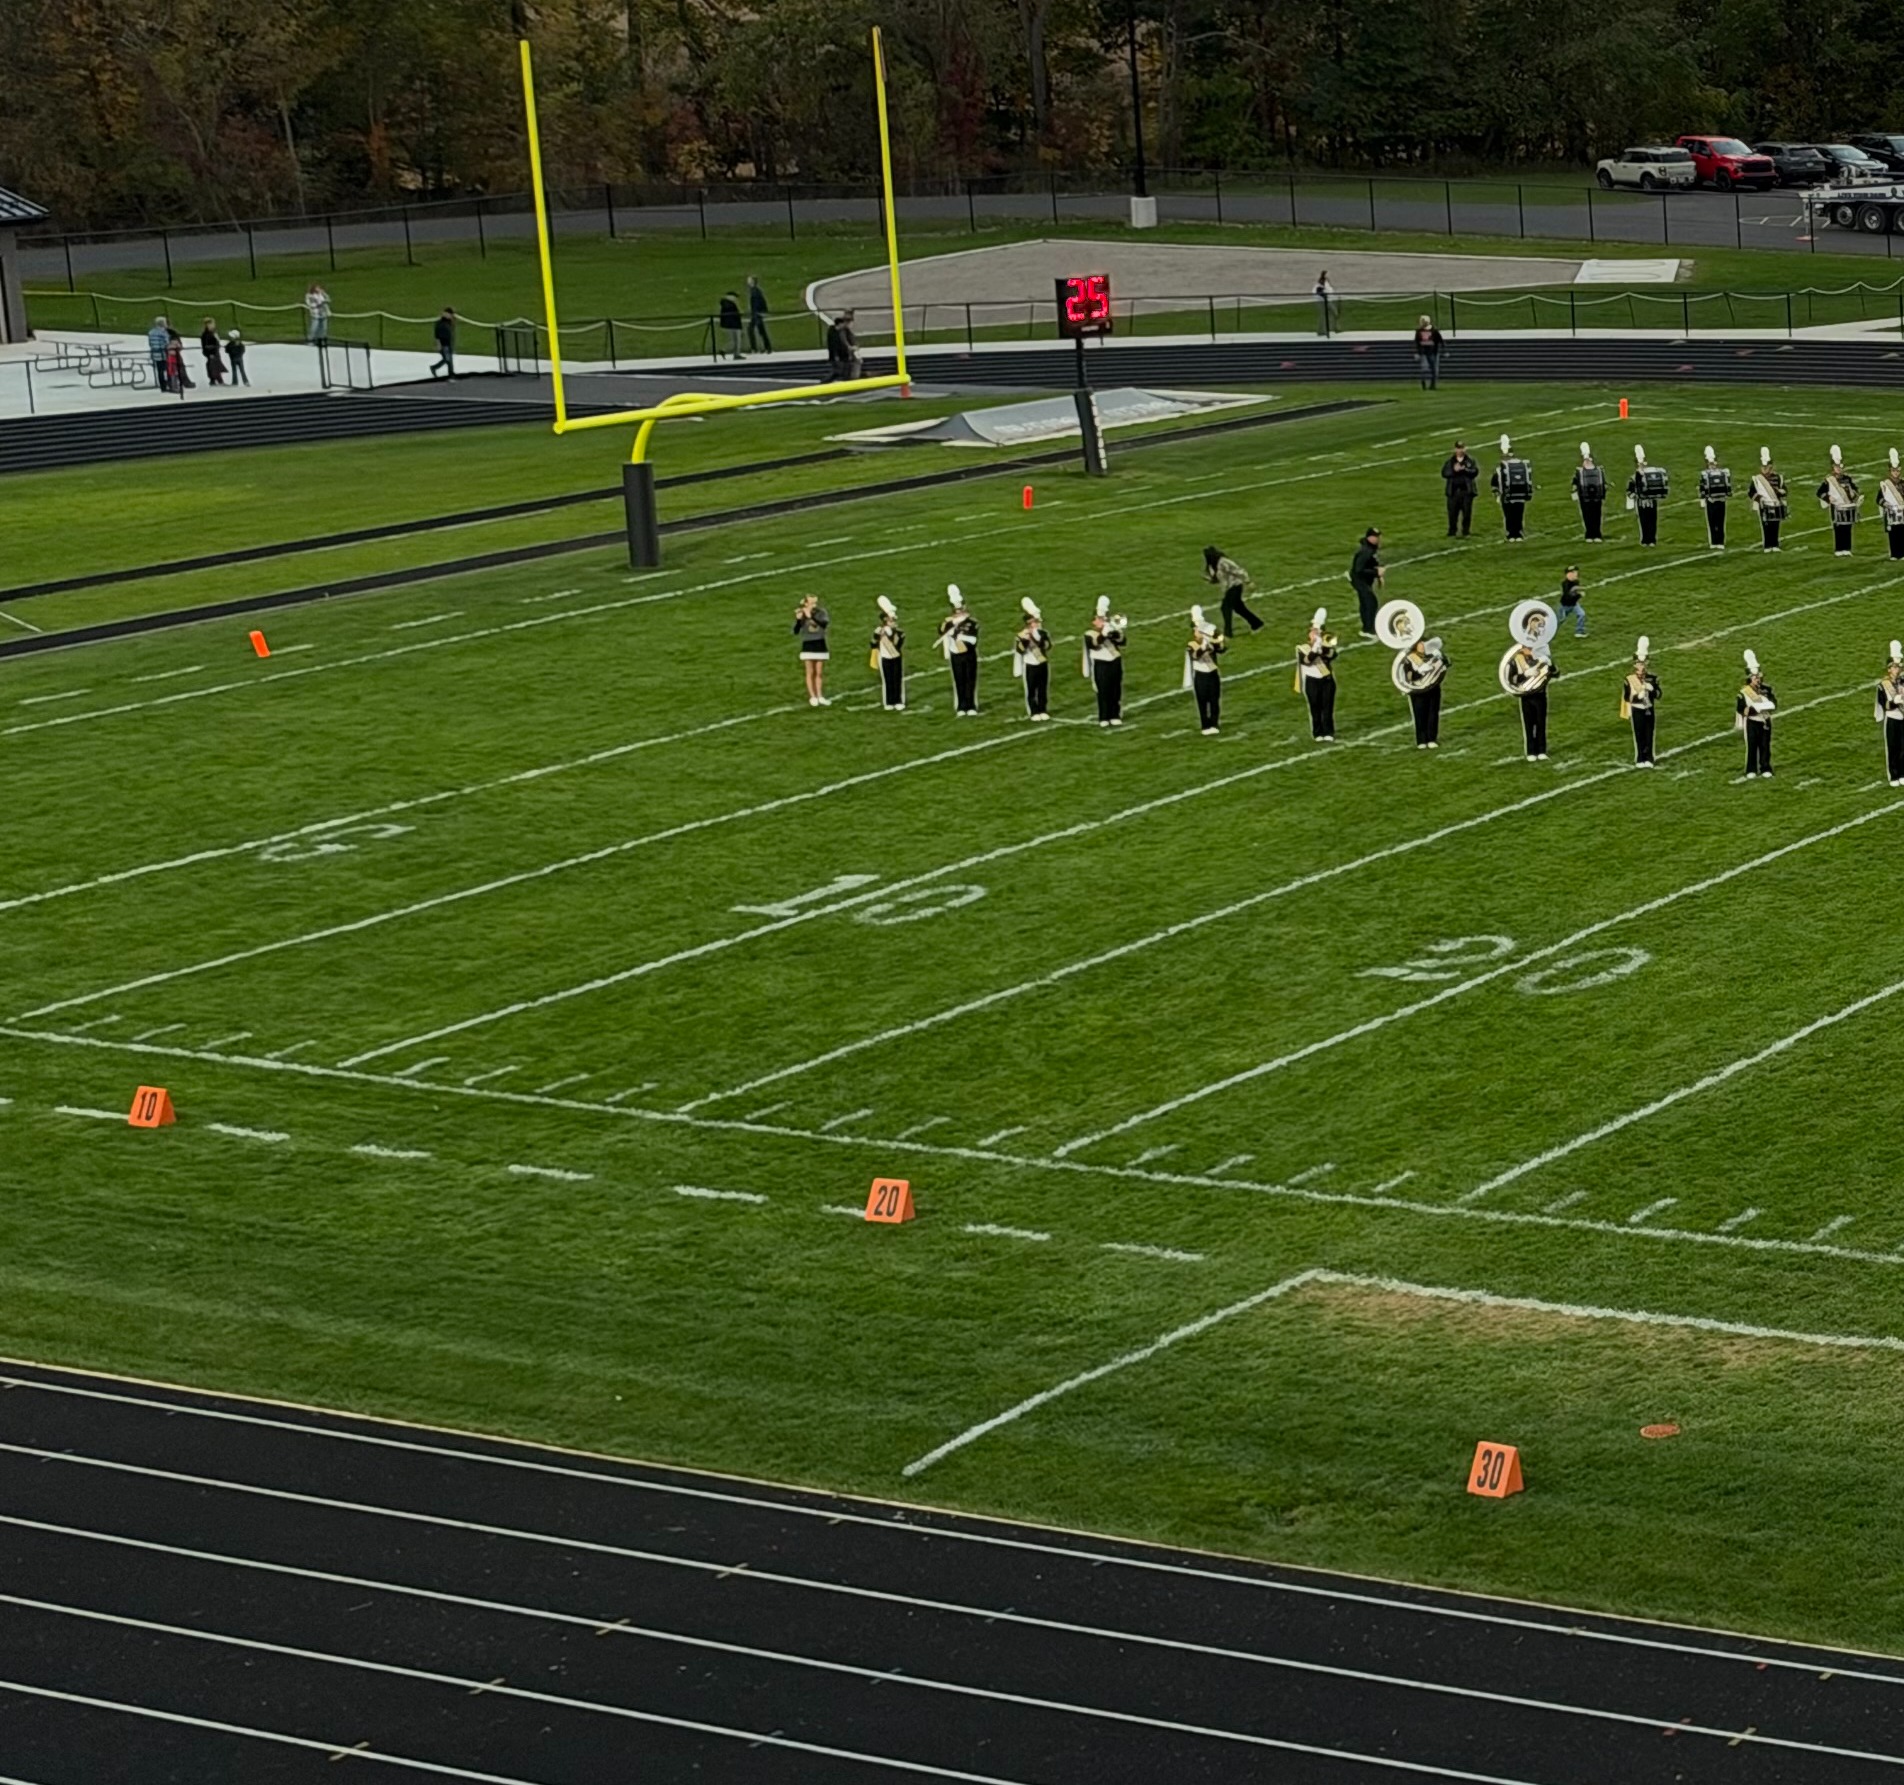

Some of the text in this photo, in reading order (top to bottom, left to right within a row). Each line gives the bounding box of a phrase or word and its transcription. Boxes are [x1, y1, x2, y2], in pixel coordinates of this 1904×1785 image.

[1065, 276, 1109, 322] 25
[729, 873, 988, 926] 10
[1352, 935, 1652, 995] 20
[137, 1089, 158, 1121] 10
[874, 1186, 901, 1218] 20
[1476, 1449, 1506, 1491] 30
